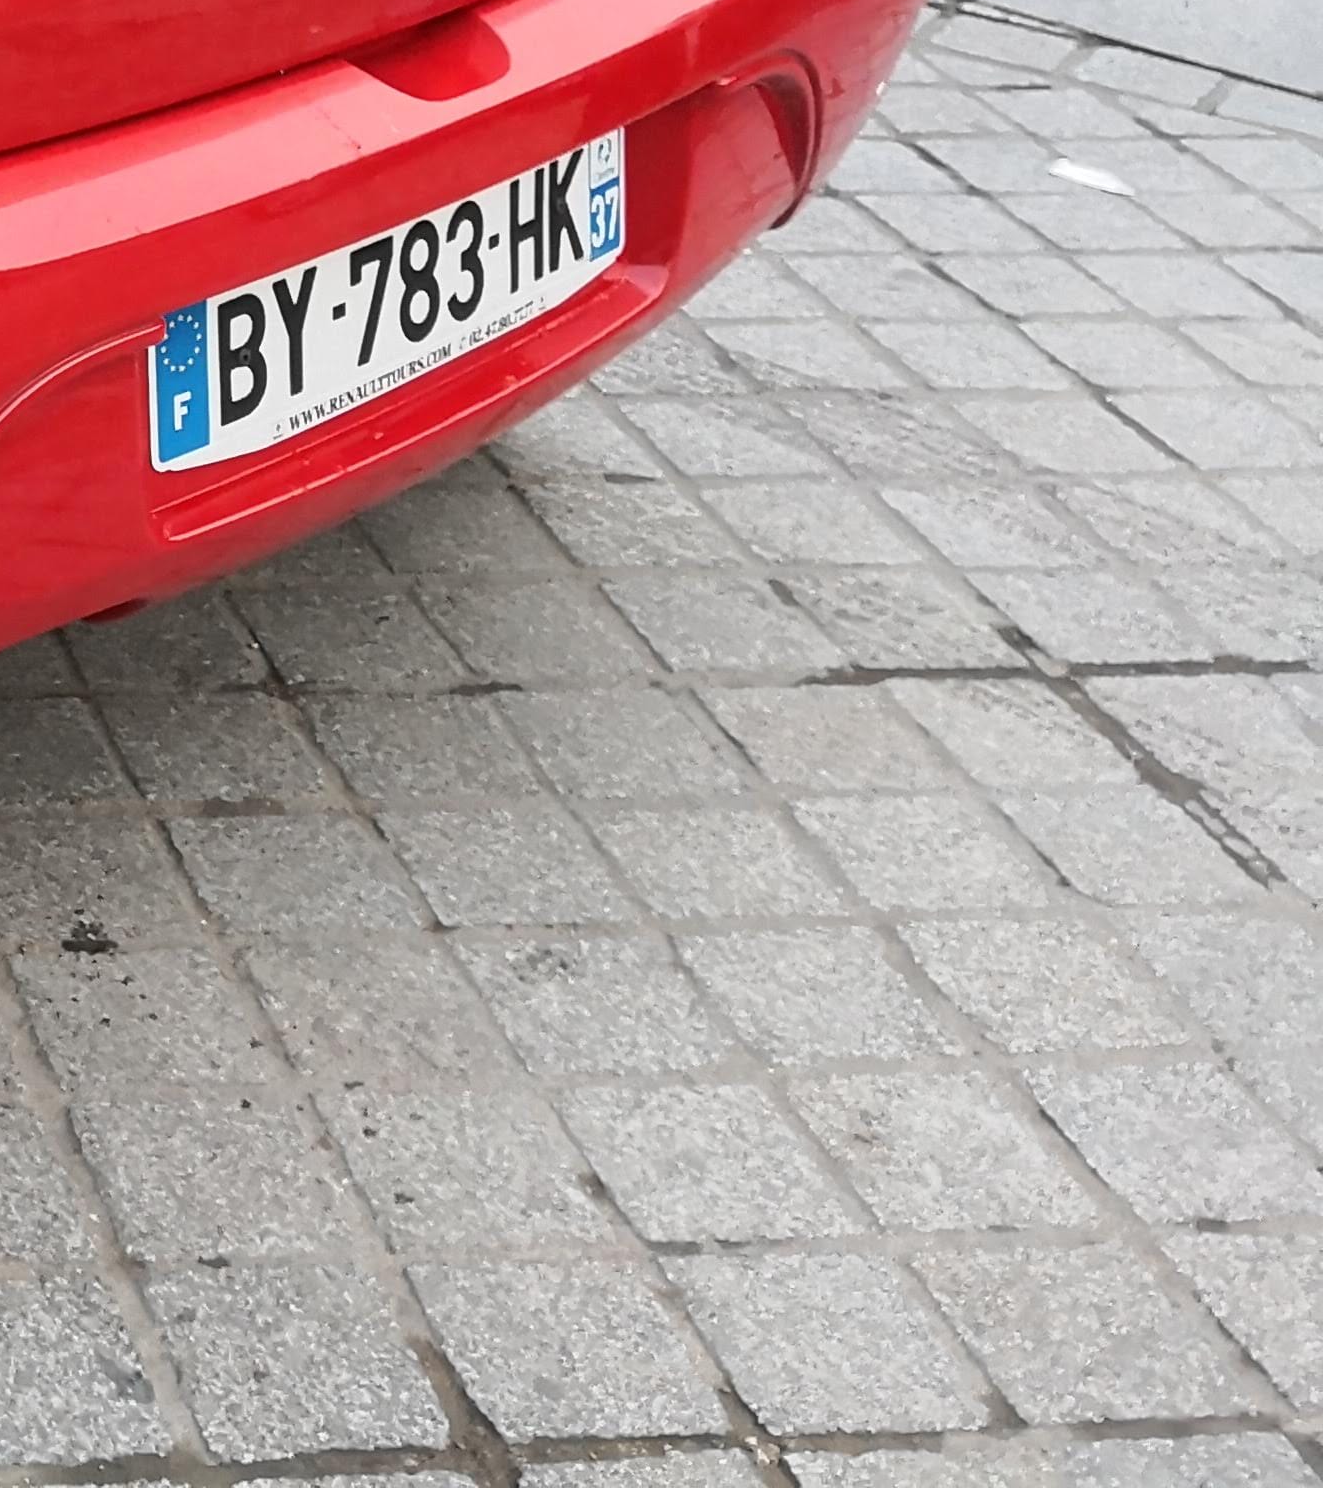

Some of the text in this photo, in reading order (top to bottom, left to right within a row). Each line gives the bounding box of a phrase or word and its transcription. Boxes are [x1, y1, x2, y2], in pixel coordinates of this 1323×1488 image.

[592, 185, 619, 249] 37
[217, 147, 584, 427] BY-783-HK
[173, 391, 192, 431] F
